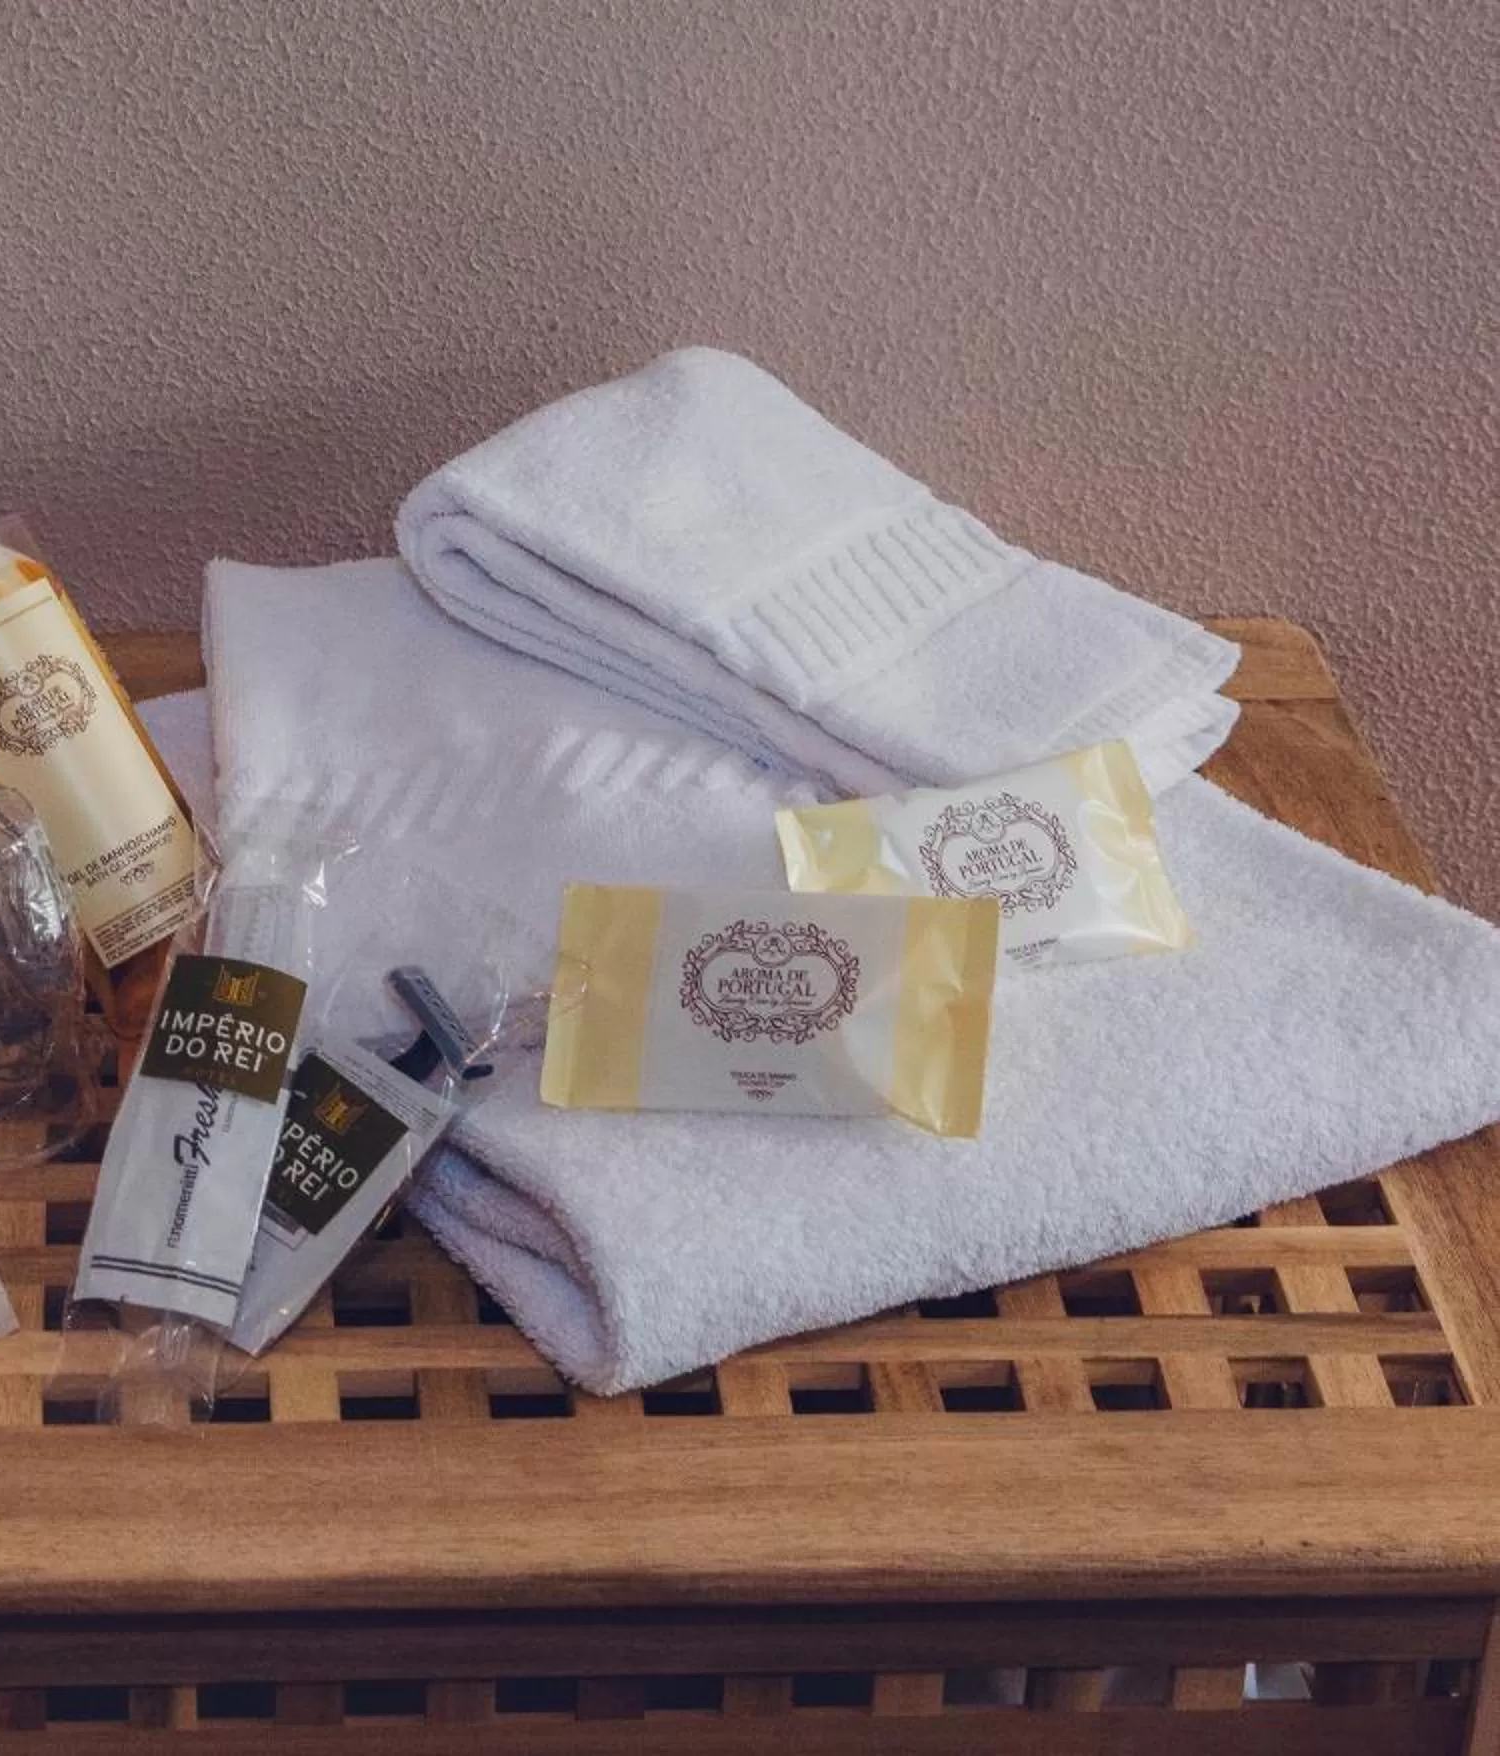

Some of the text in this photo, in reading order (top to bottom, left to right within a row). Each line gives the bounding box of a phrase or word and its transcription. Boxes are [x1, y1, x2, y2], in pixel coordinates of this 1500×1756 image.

[959, 849, 1043, 880] PORTUGAL
[965, 839, 1028, 862] AROMA DE
[716, 978, 818, 998] PORTUGAL
[731, 966, 809, 982] AROMA DE
[160, 1008, 286, 1055] IMPÉRIO
[165, 1033, 263, 1074] DO REI
[281, 1121, 360, 1189] PÉRIO
[281, 1159, 330, 1202] REI
